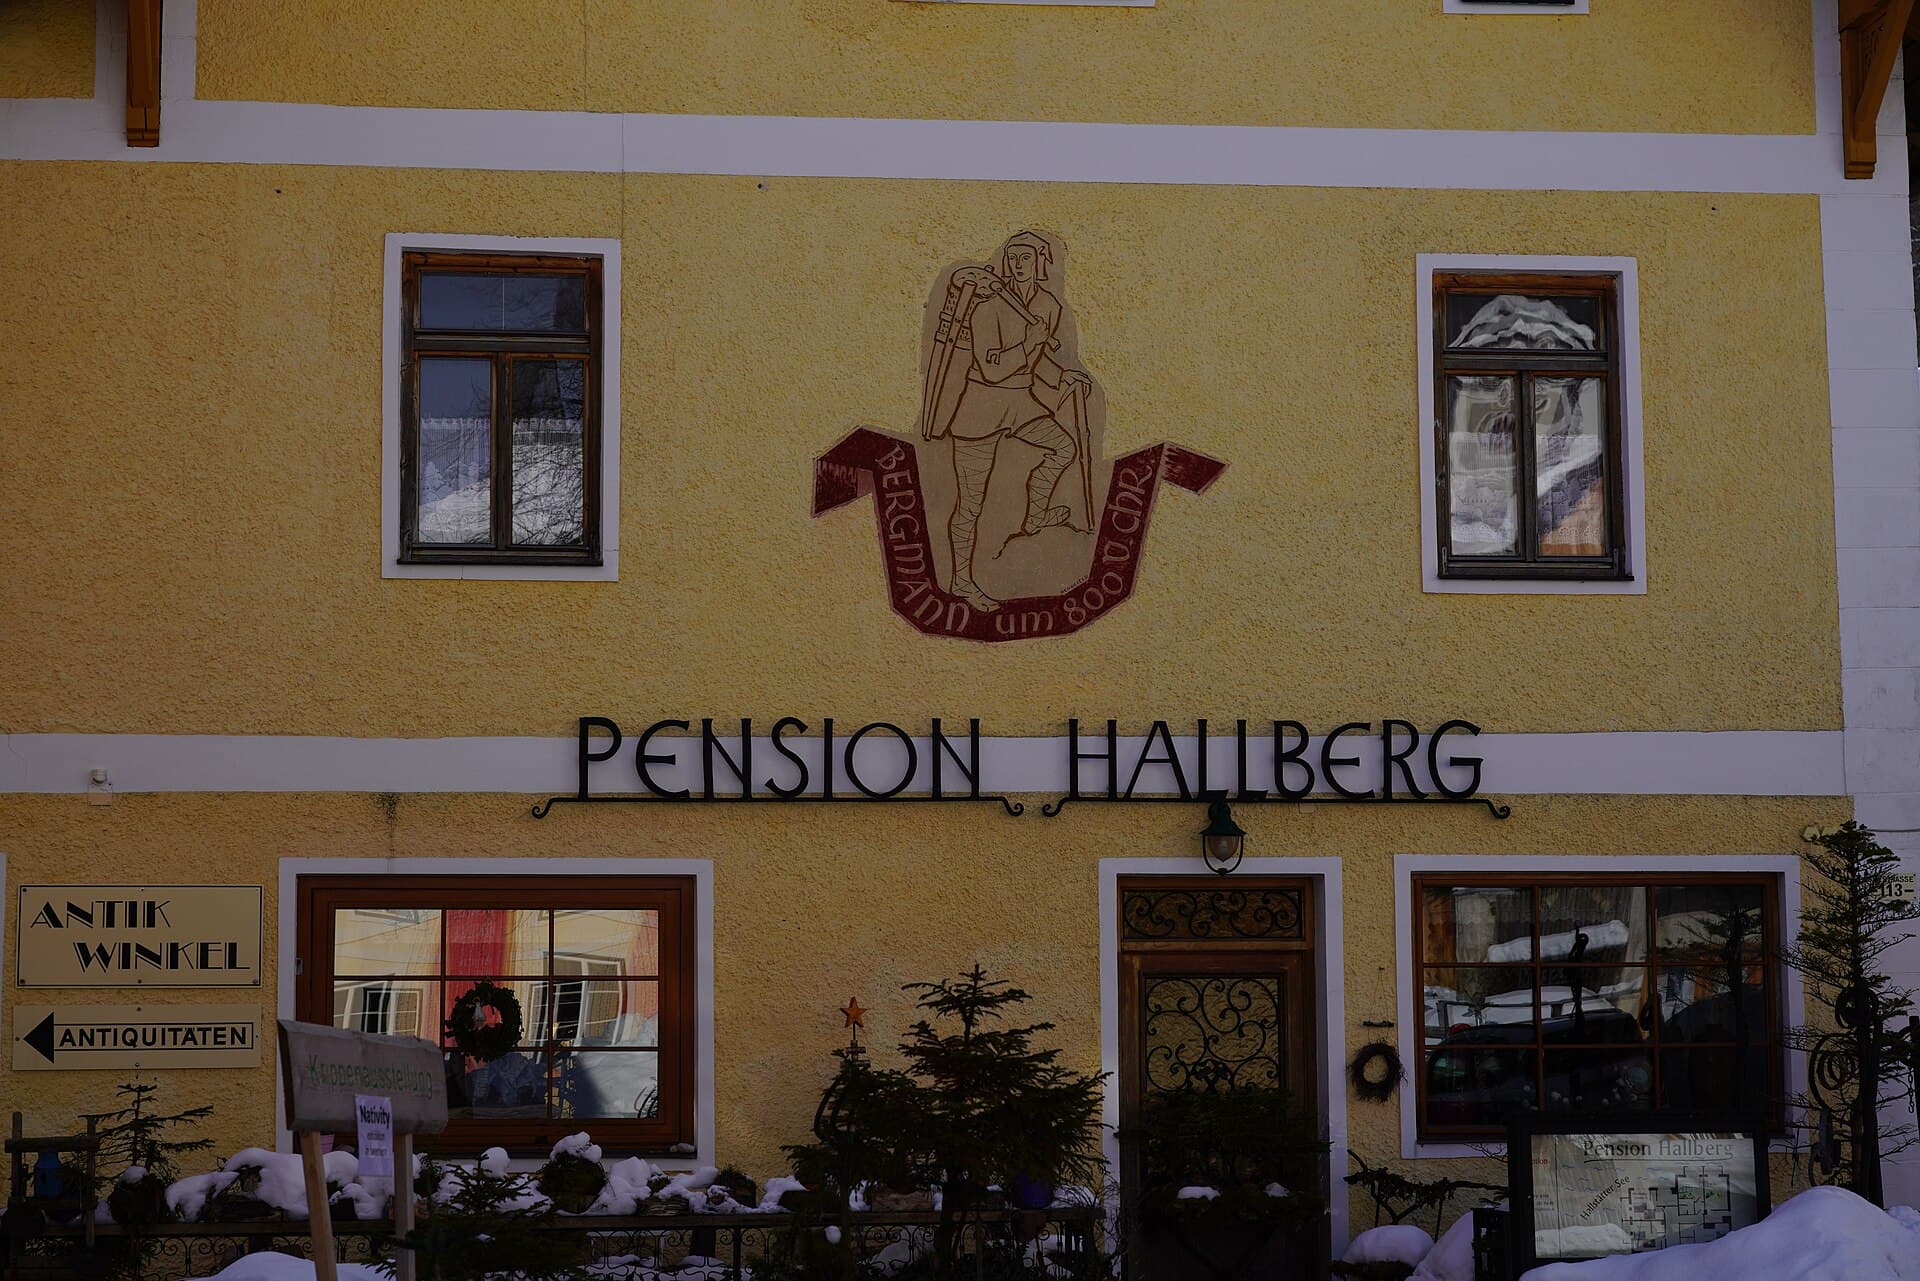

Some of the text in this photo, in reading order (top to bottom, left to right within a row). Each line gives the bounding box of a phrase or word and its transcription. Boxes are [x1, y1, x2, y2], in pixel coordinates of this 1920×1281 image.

[995, 610, 1055, 634] um
[1063, 571, 1125, 627] 800
[577, 717, 1482, 799] PENSION HALLBERG
[30, 900, 172, 929] ANTIK
[73, 942, 250, 973] WINKEL
[59, 1026, 247, 1048] ANTIQUITÄTEN
[359, 1105, 391, 1129] Nativity
[1584, 1139, 1734, 1159] Pension Hallberg
[1614, 1174, 1631, 1189] See
